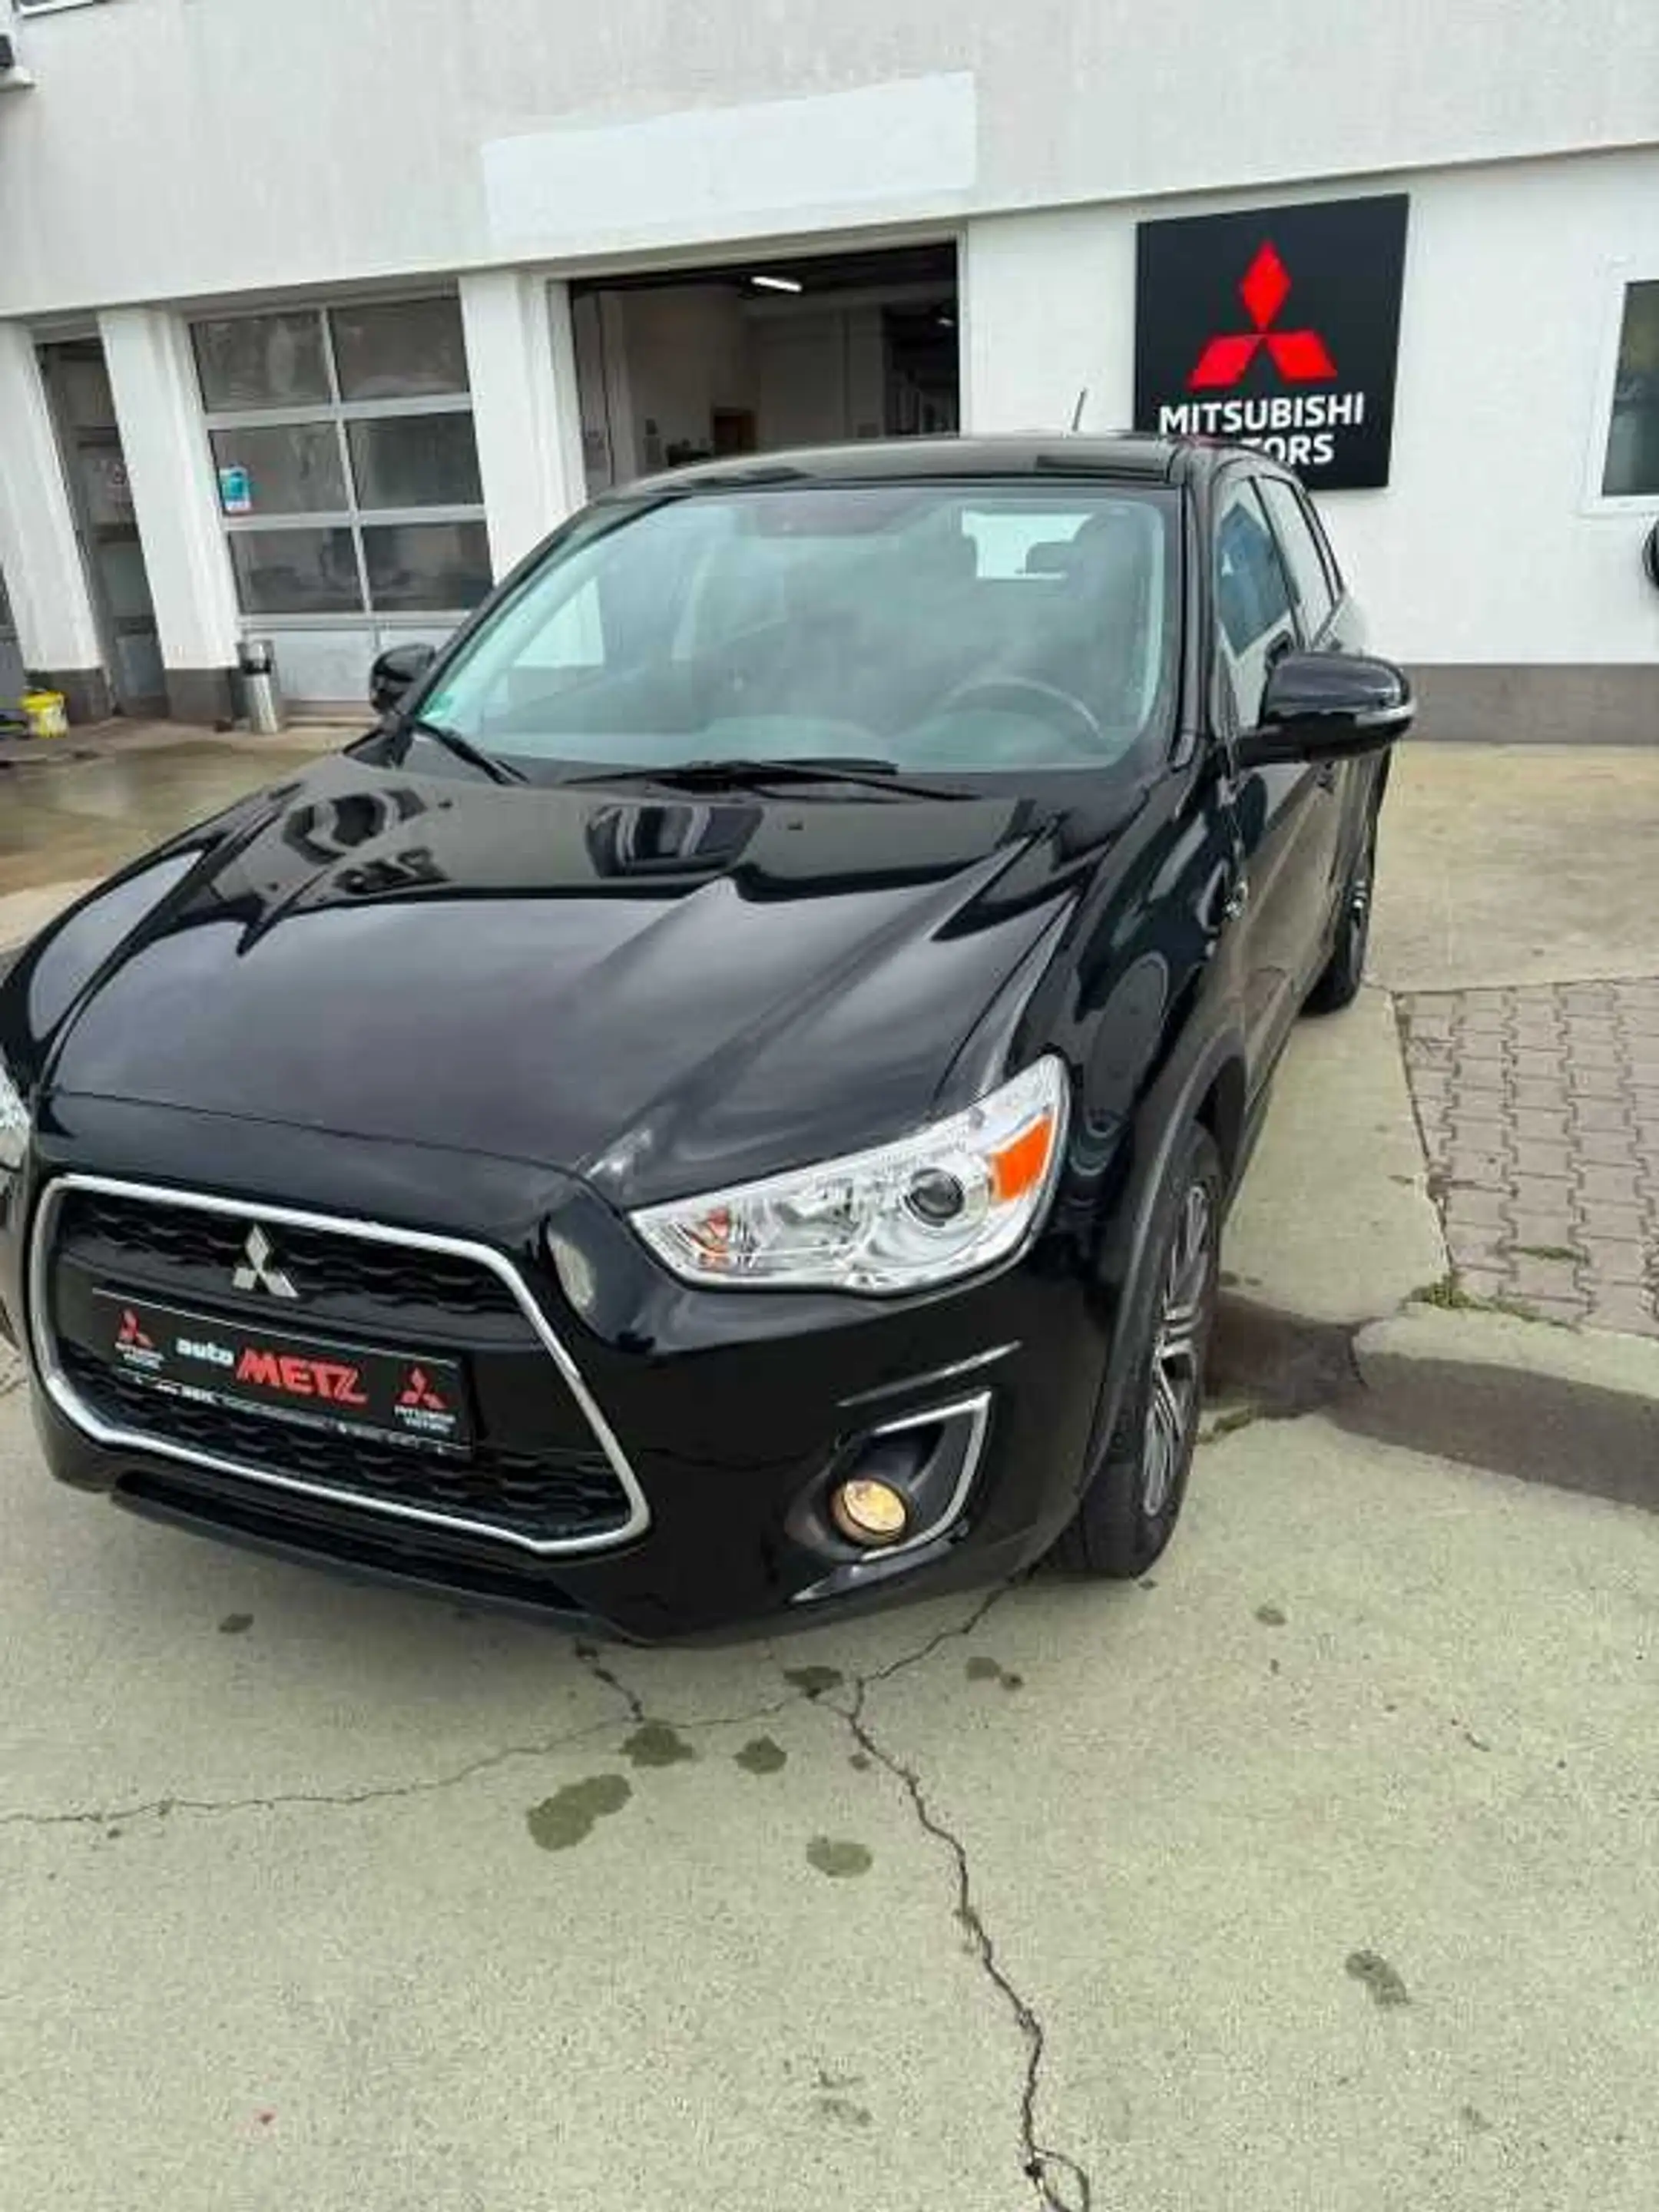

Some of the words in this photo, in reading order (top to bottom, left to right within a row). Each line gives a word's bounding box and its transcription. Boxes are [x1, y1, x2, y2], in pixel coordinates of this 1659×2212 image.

[1159, 392, 1364, 435] MITSUBISHI
[1240, 433, 1335, 465] ORS
[175, 1337, 234, 1366] auto
[236, 1347, 369, 1404] METZ
